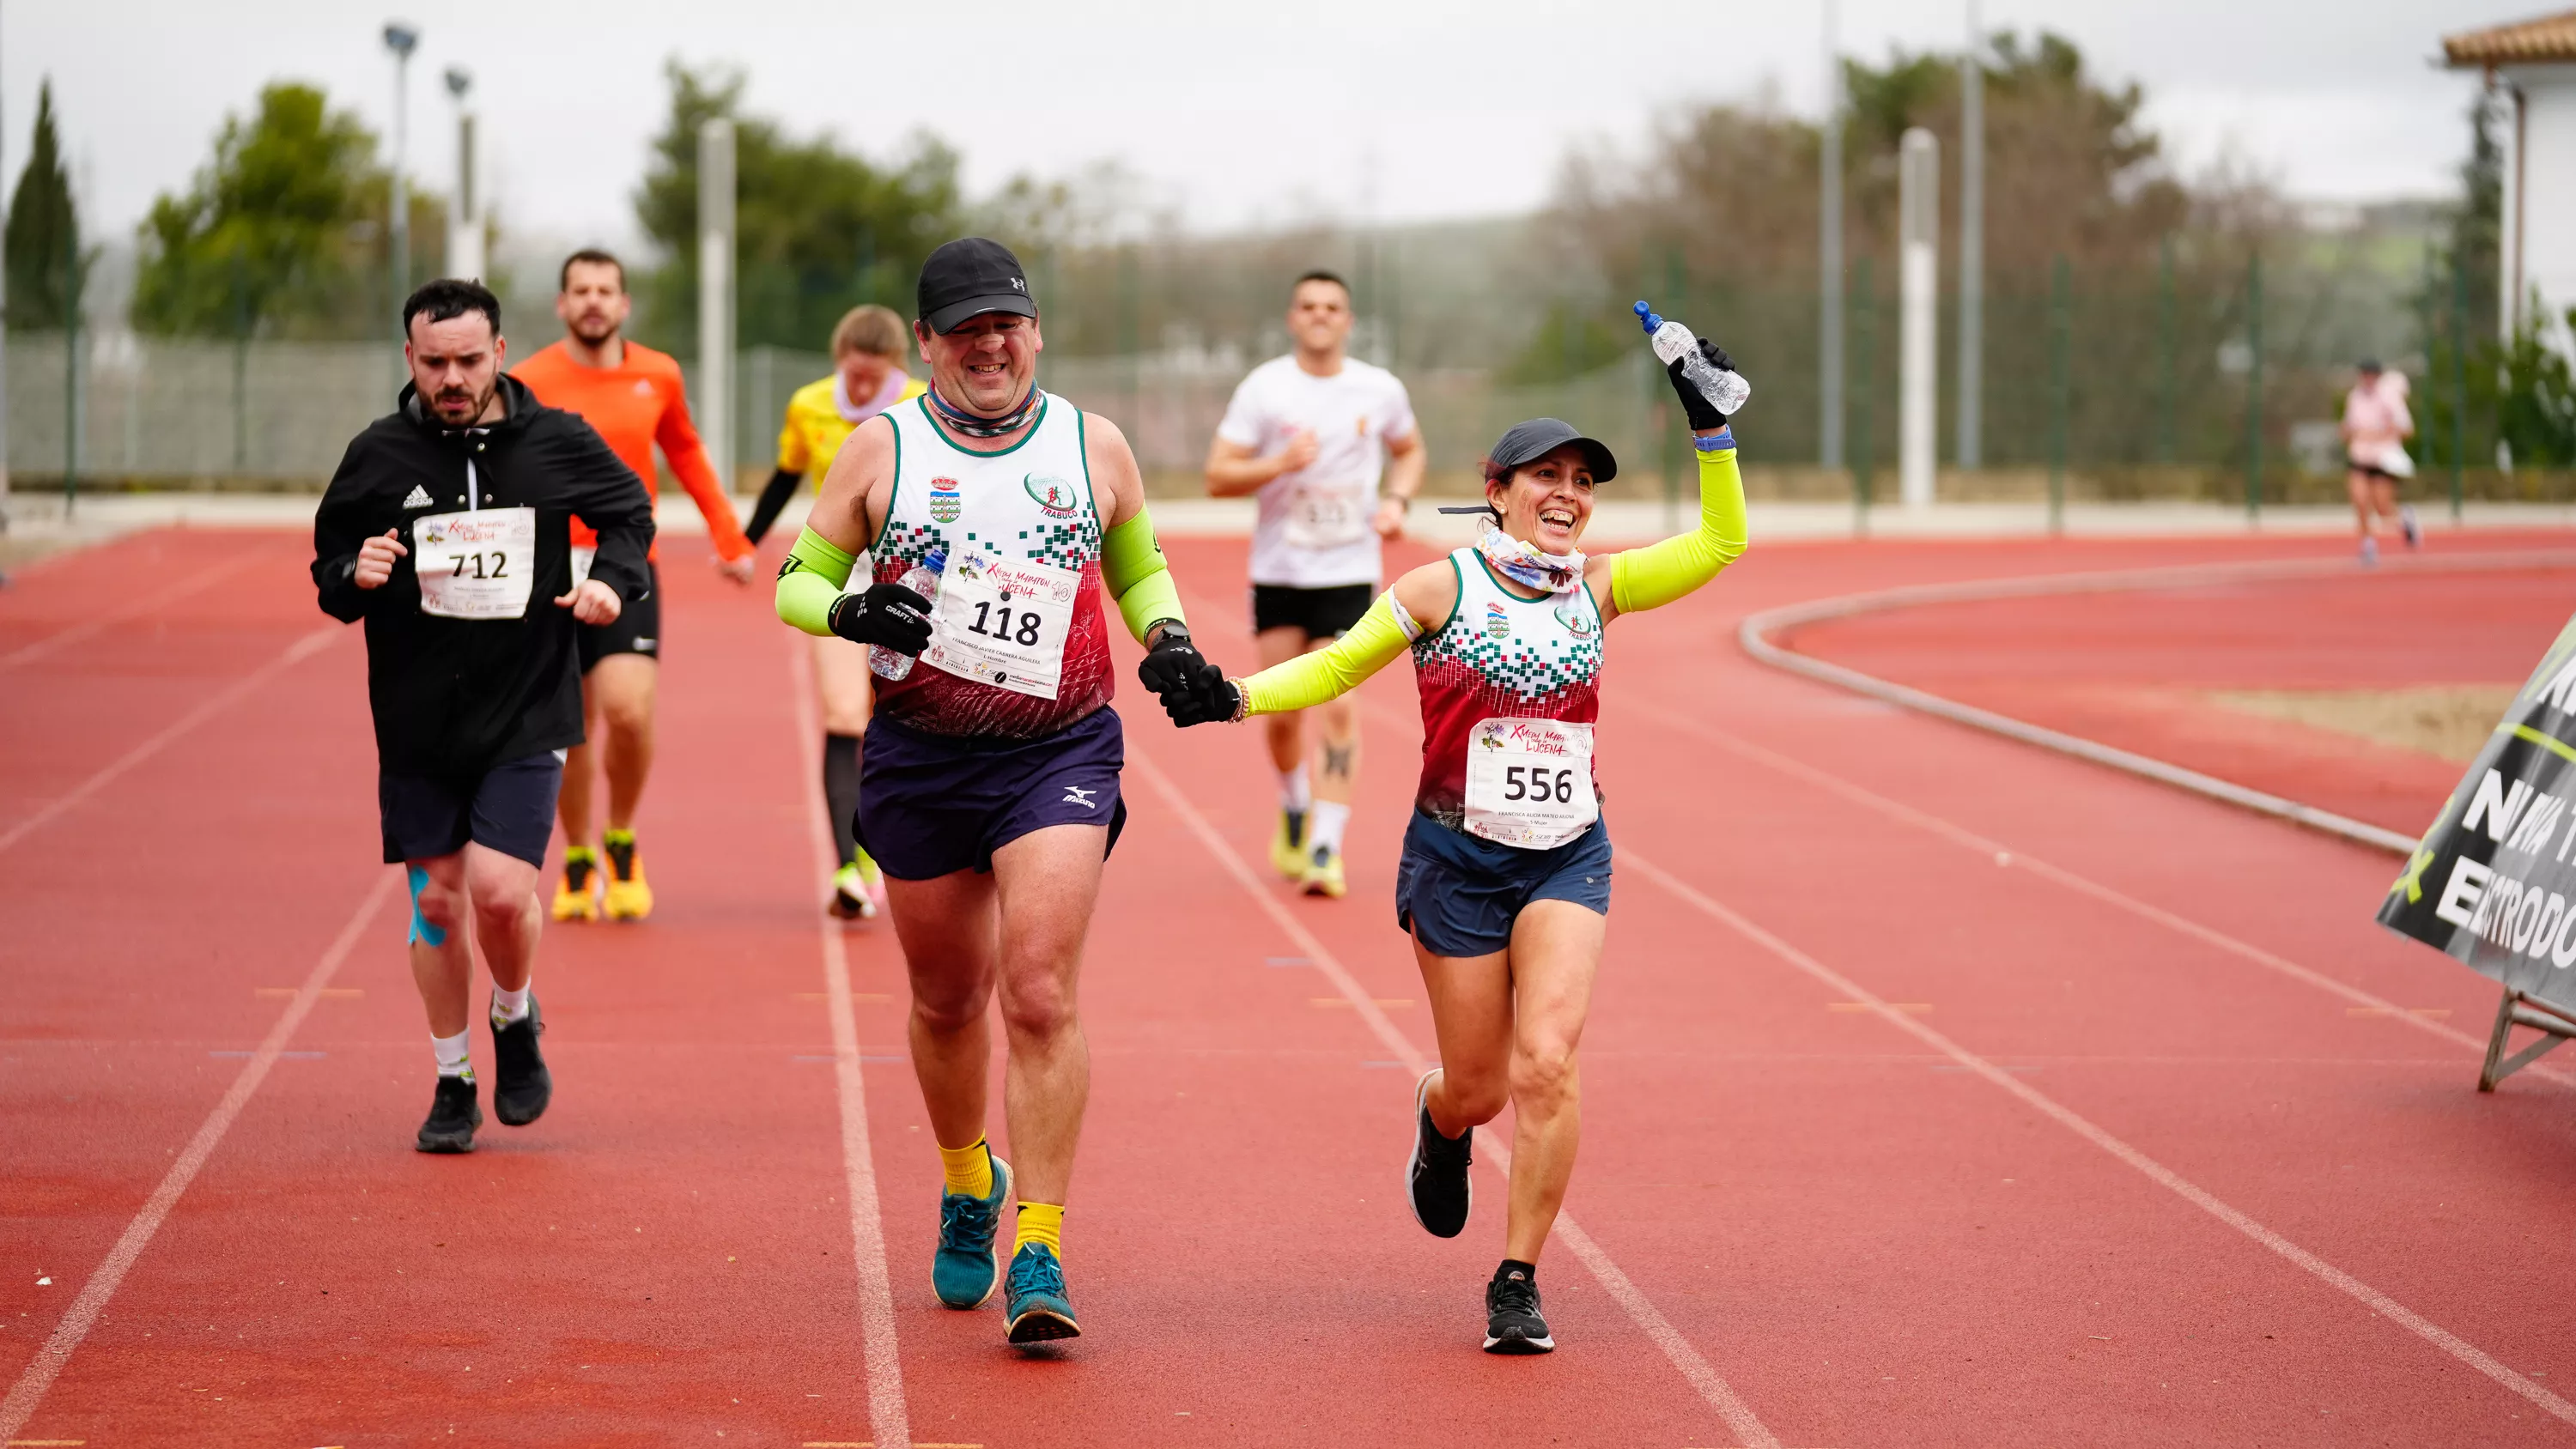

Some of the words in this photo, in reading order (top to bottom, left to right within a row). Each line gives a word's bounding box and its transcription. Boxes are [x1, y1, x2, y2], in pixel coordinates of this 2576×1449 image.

[403, 496, 434, 508] adidas
[1040, 506, 1078, 519] TRABUCO
[448, 550, 508, 579] 712
[885, 604, 910, 621] CRAFT
[968, 601, 1042, 646] 118
[1568, 630, 1593, 641] TRABUCO
[951, 637, 979, 650] FRANCISCO
[979, 646, 996, 654] JAVIER
[1526, 739, 1568, 756] LUCENA
[1504, 766, 1572, 803] 556
